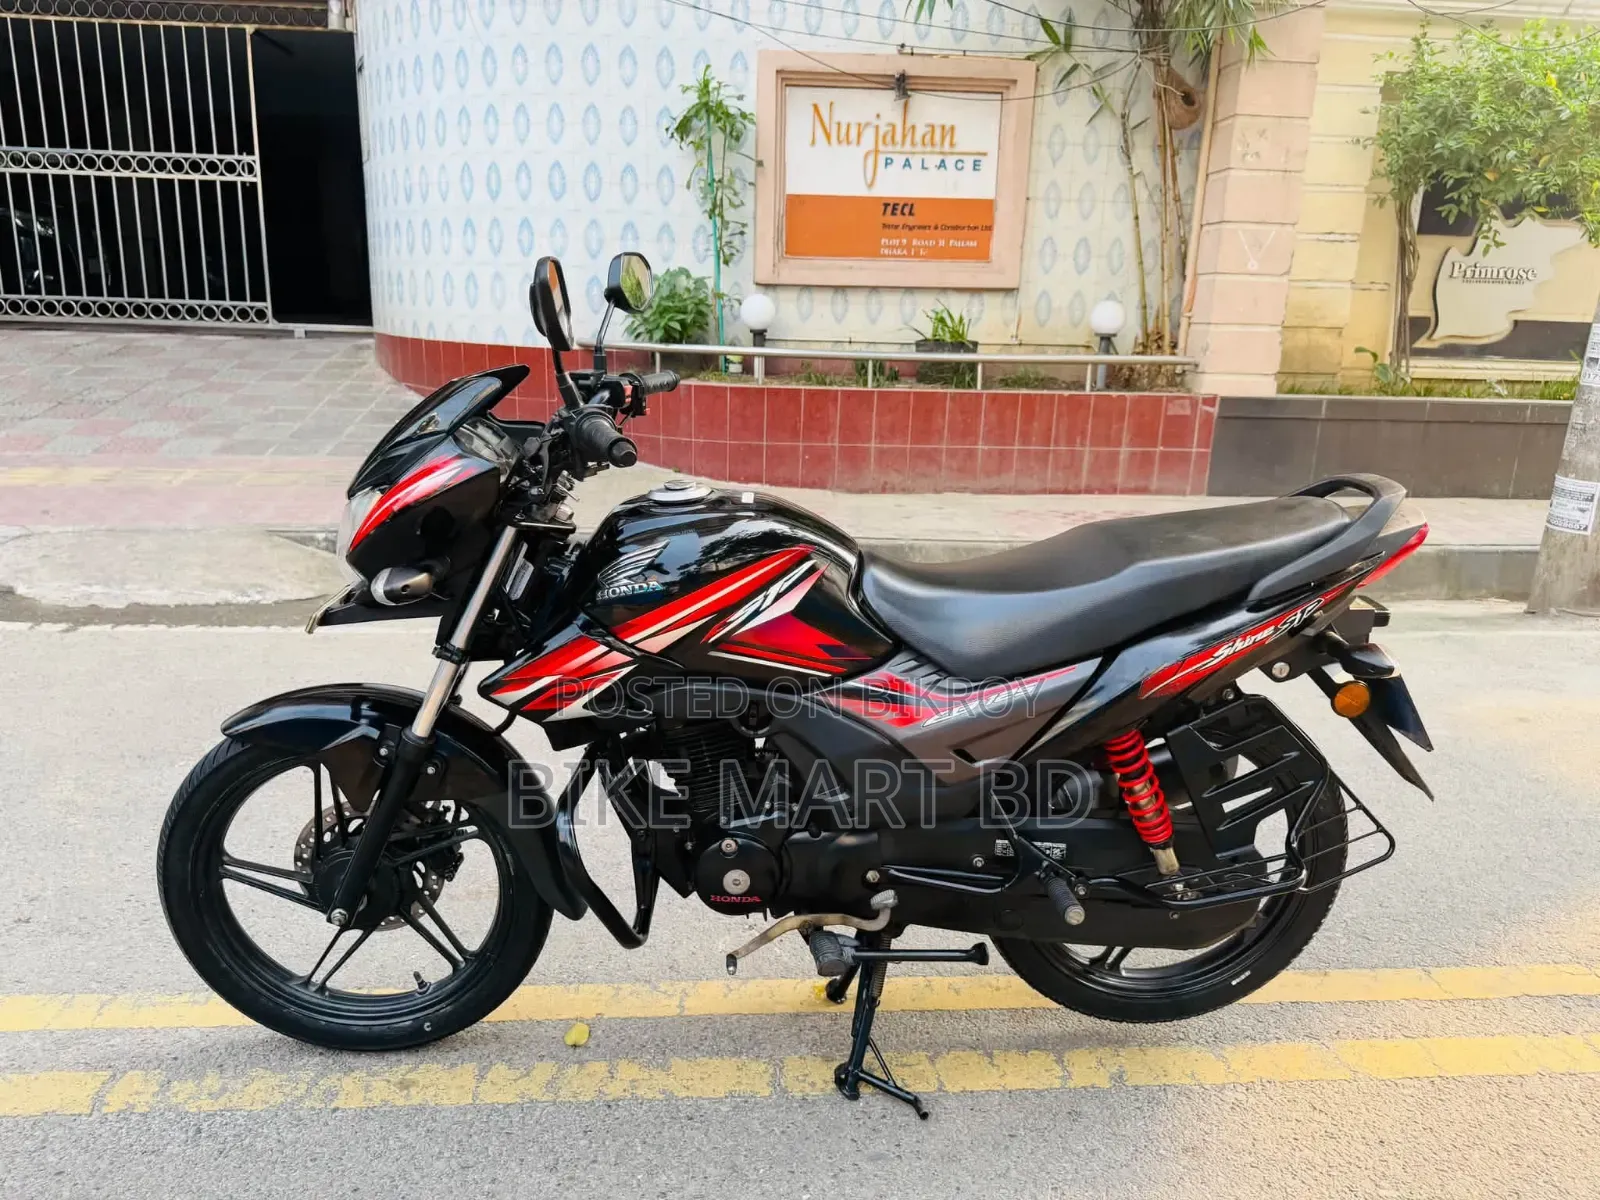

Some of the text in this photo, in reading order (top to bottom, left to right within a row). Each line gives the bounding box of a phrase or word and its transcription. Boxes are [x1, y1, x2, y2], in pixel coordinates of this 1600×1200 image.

[810, 99, 957, 189] Nurjahan
[884, 156, 982, 172] PALACE
[881, 202, 915, 217] TECL
[880, 247, 907, 256] DHAKA
[912, 238, 936, 248] ROAD
[1448, 261, 1538, 281] Primrose
[596, 581, 663, 600] HONDA
[1196, 624, 1276, 672] Shine
